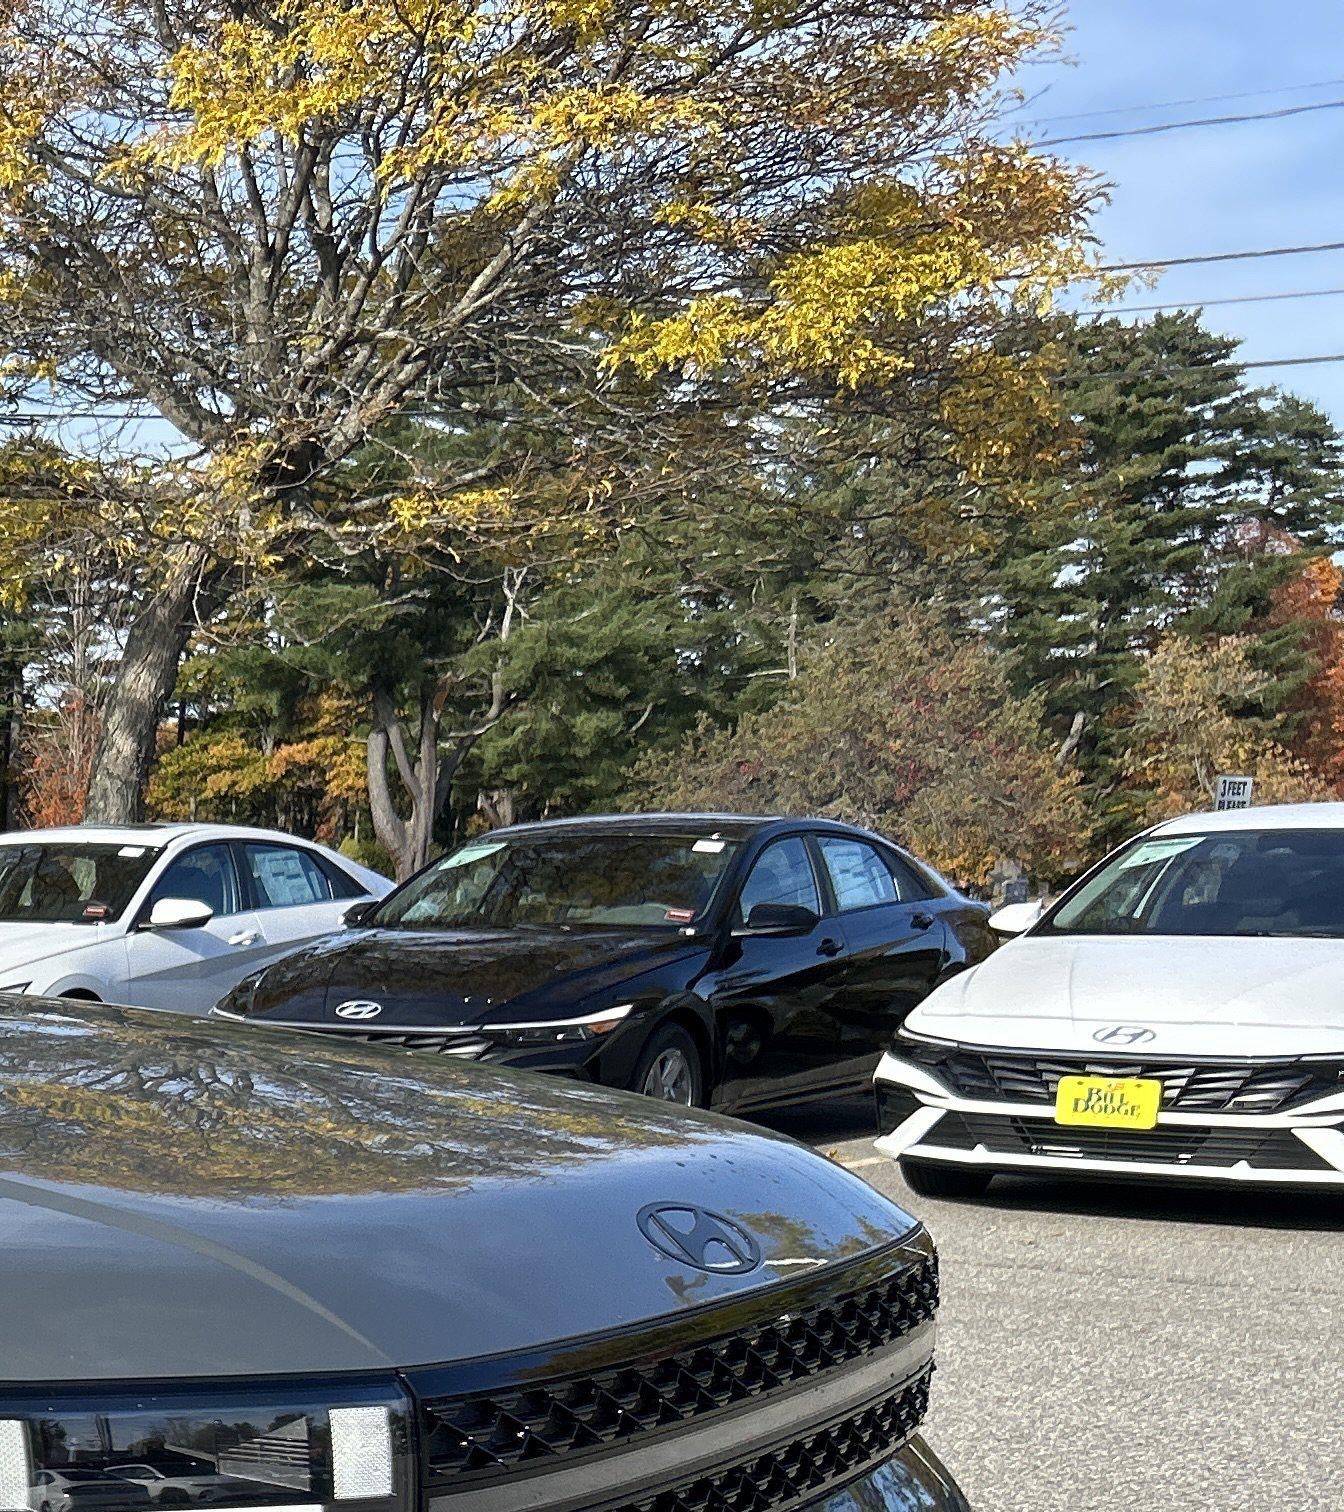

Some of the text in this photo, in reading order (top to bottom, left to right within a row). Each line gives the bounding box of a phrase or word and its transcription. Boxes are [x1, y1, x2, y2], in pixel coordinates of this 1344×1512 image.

[1227, 781, 1247, 796] FEET
[1086, 1087, 1130, 1105] BILL
[1072, 1097, 1142, 1119] DODGE
